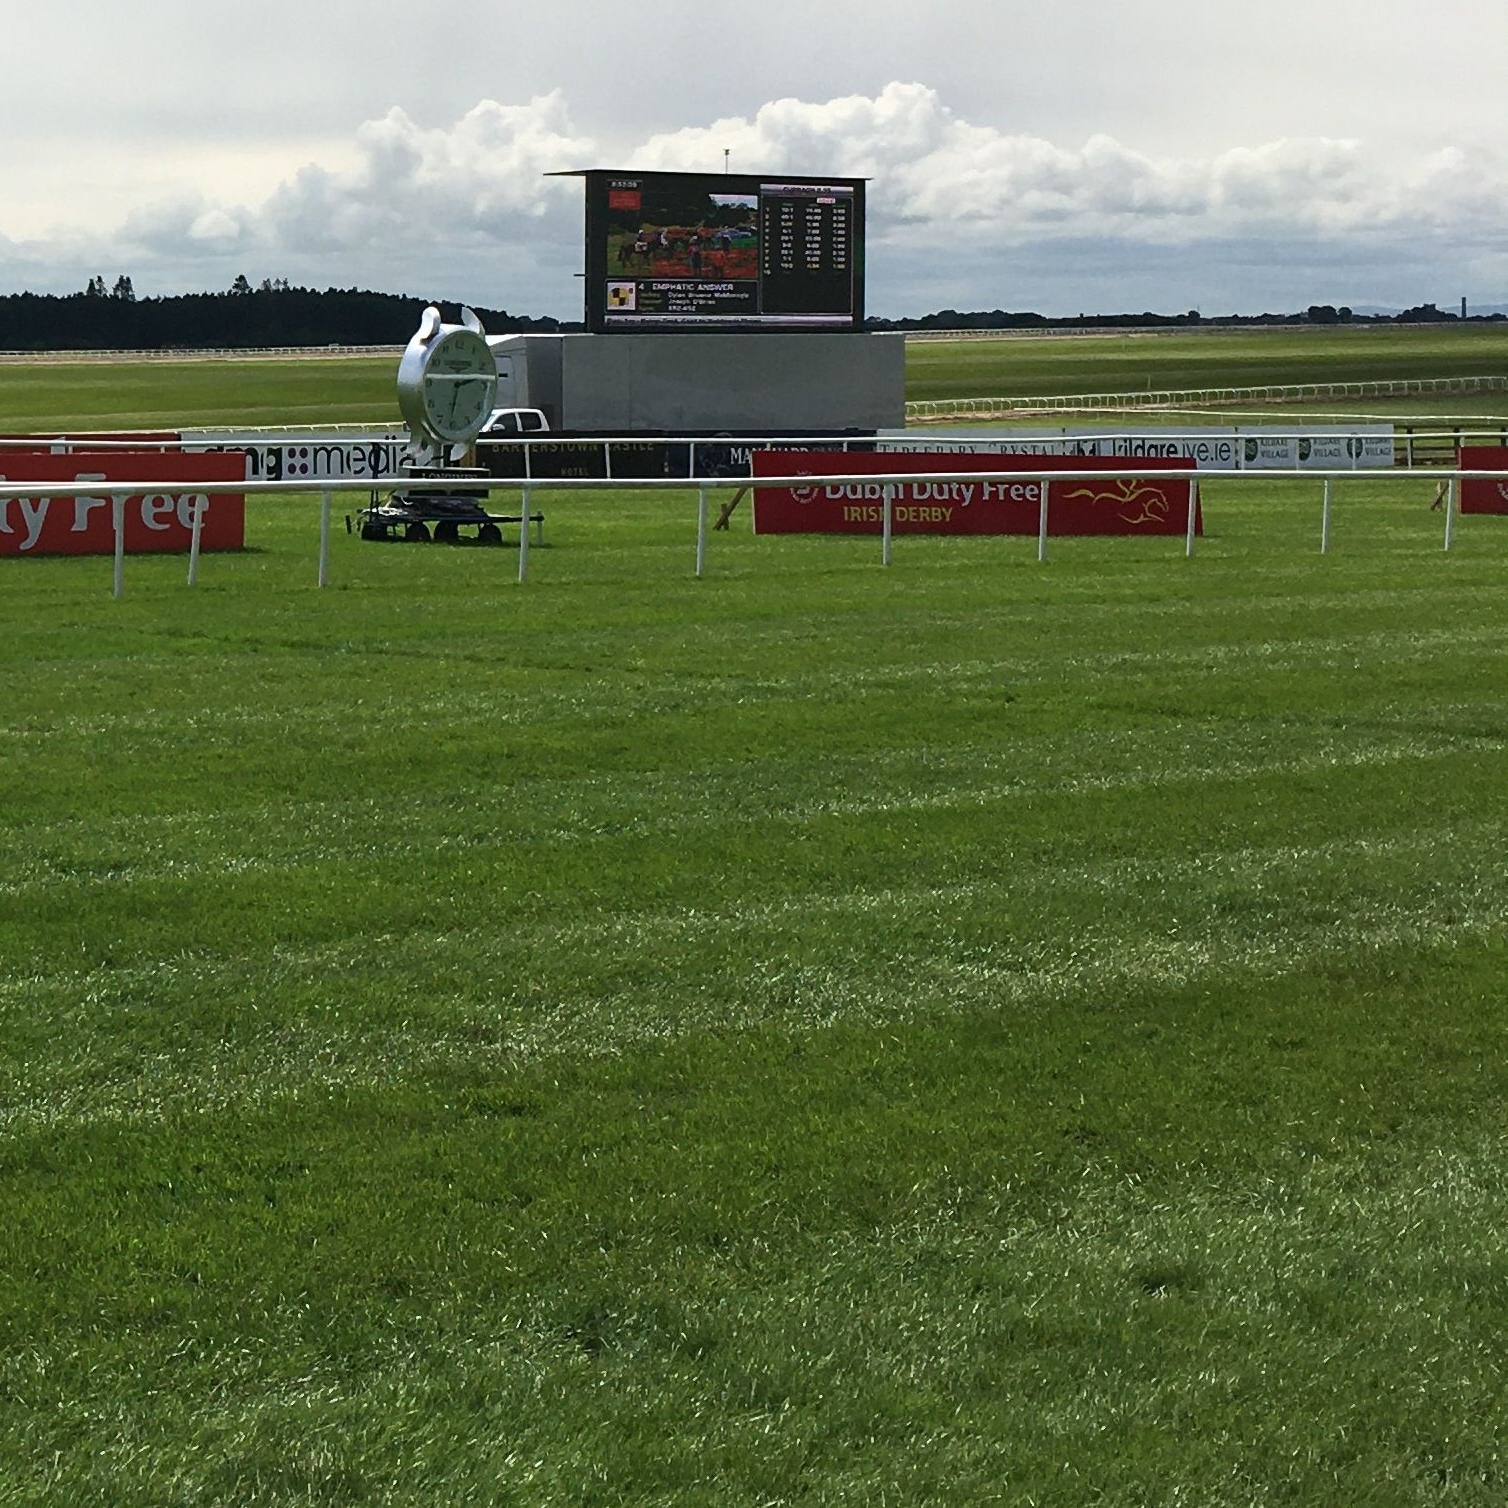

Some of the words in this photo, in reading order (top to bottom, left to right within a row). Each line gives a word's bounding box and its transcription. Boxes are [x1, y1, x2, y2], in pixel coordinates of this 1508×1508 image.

[652, 283, 694, 291] EMPHATIC
[697, 283, 734, 291] ANSWER
[605, 442, 655, 452] ASTLE
[911, 480, 974, 507] Duty
[982, 479, 1039, 502] Free
[895, 506, 954, 523] DERBY
